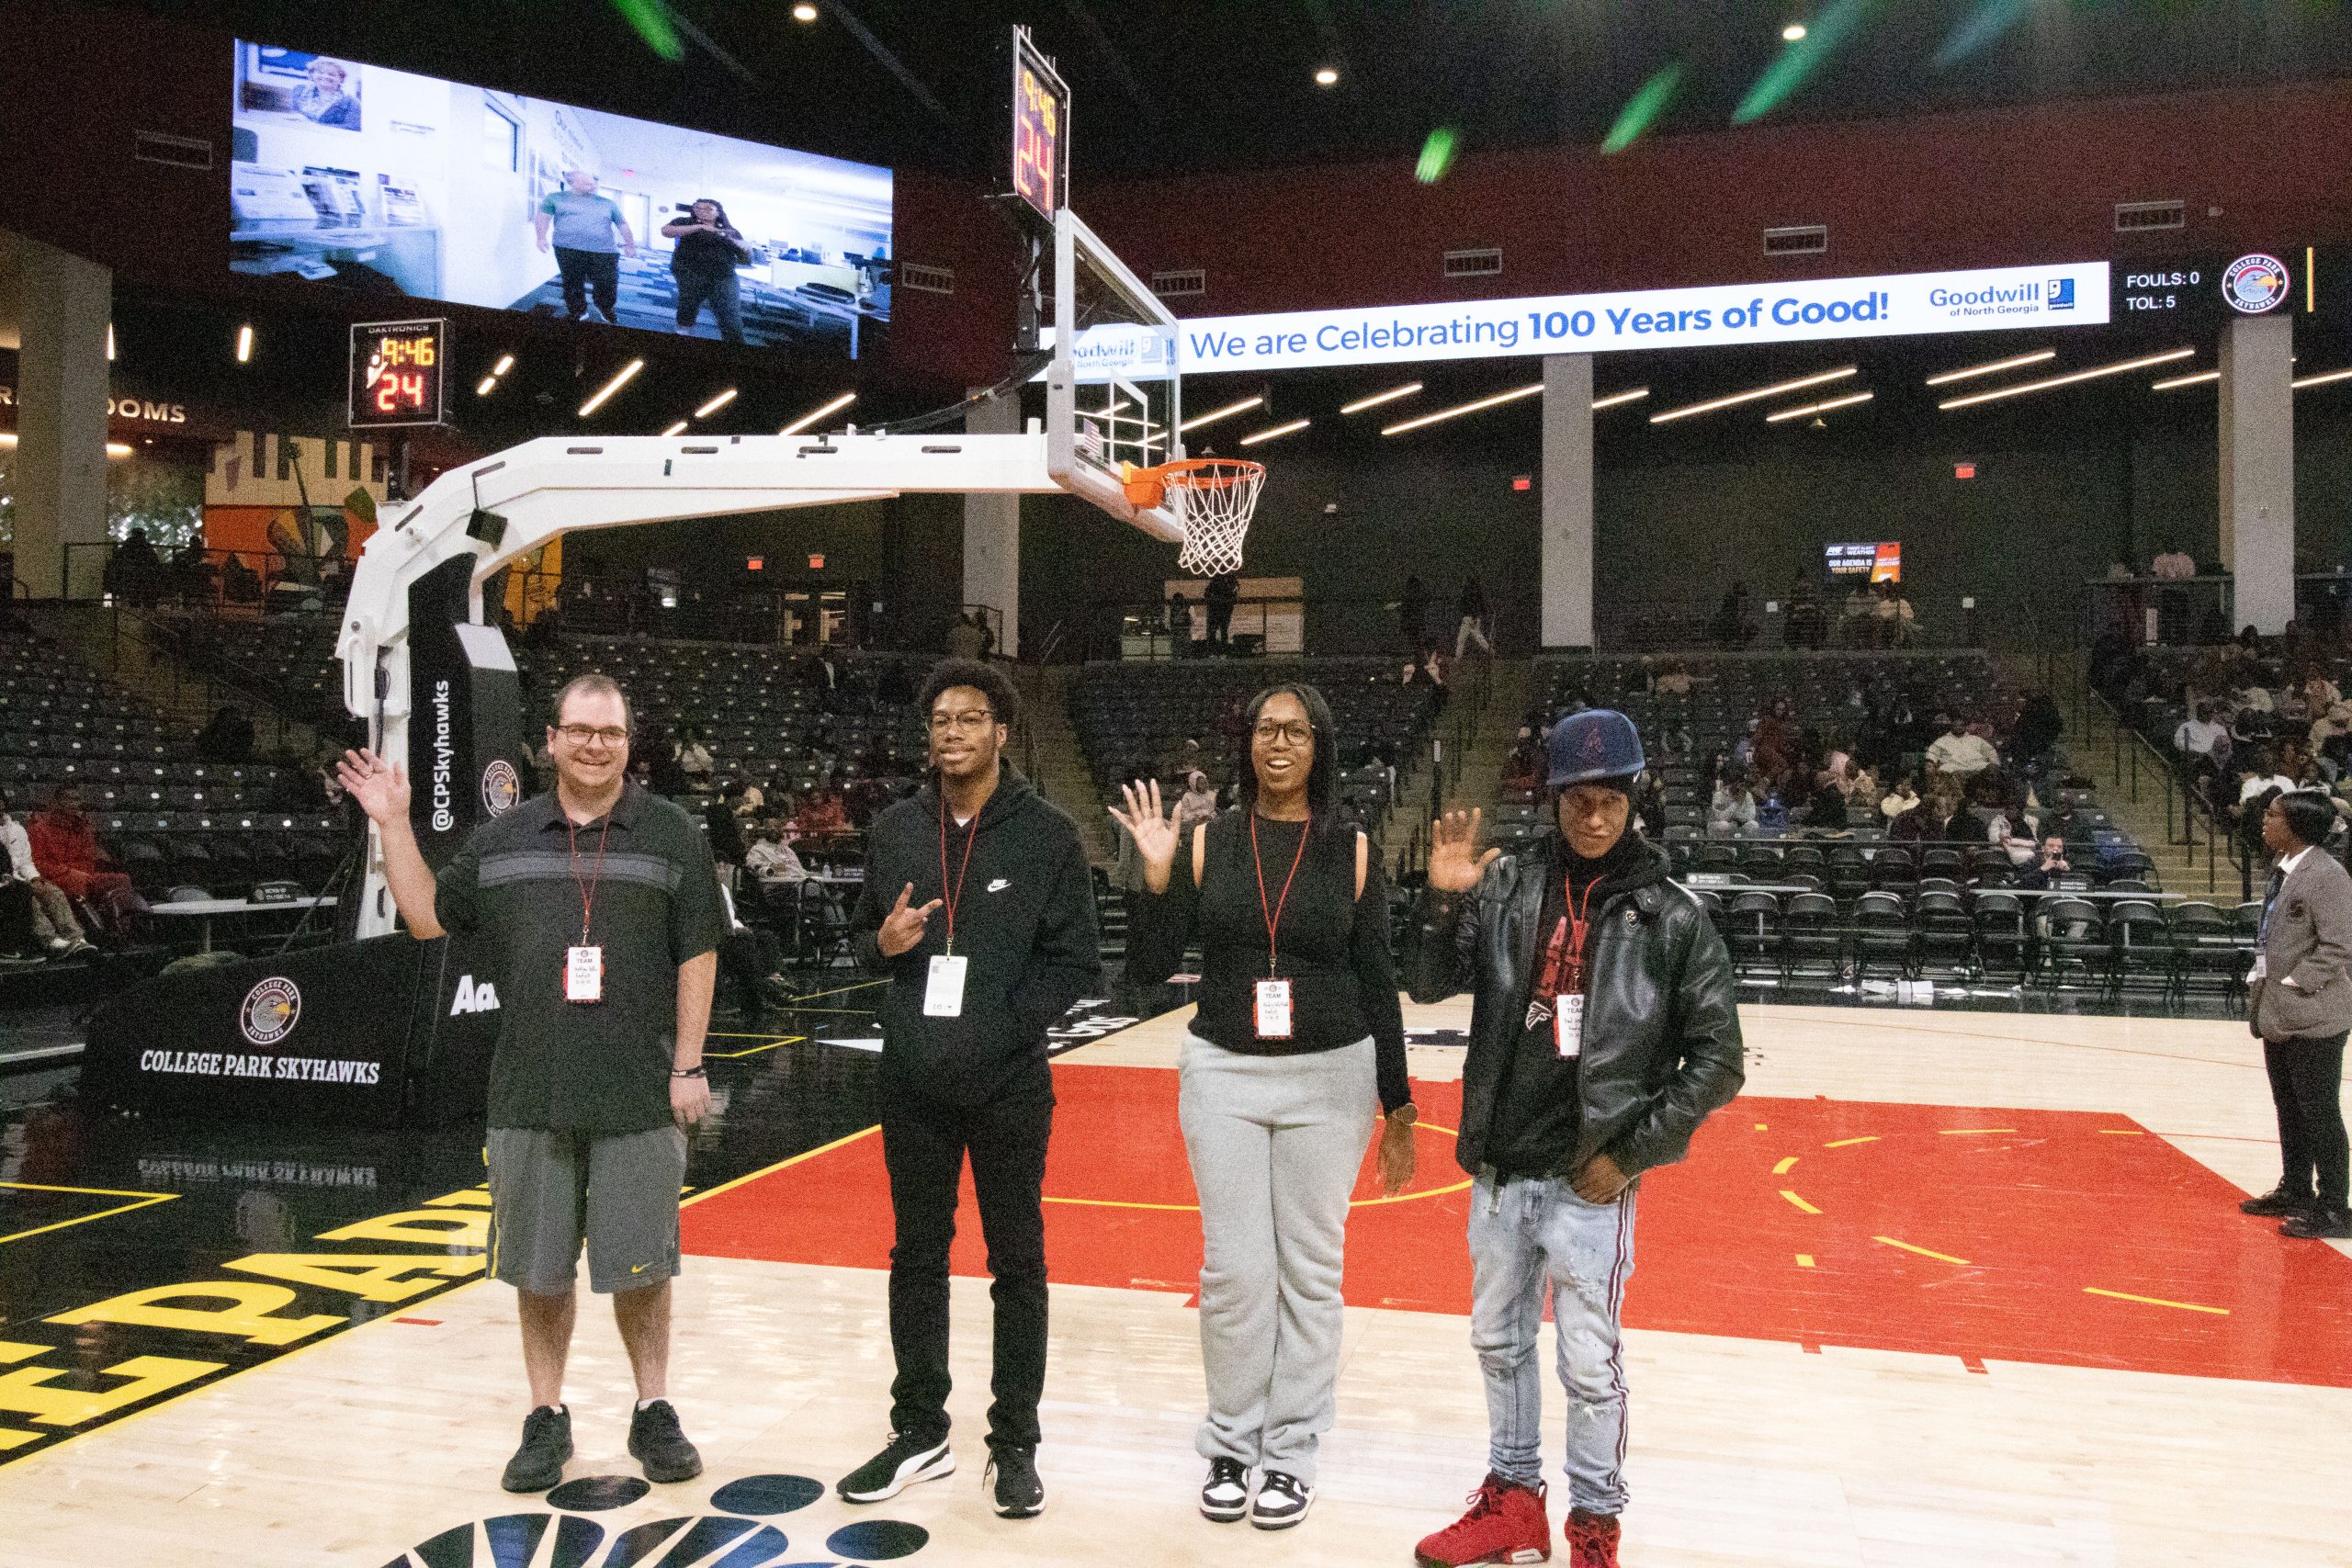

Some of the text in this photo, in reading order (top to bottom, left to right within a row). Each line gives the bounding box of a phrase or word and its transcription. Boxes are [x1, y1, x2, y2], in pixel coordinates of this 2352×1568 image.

[1017, 115, 1051, 210] 24
[1929, 283, 2040, 307] Goodwill
[2126, 271, 2199, 288] FOULS: 0
[1950, 304, 2040, 317] of North Georgia
[2126, 295, 2176, 310] TOL: 5
[368, 324, 430, 333] DAKTRONICS
[1191, 332, 1245, 359] We
[1254, 333, 1307, 355] are
[1317, 315, 1520, 352] Celebrating
[1528, 310, 1596, 340] 100
[1606, 307, 1713, 335] Years
[1722, 298, 1764, 329] of
[1771, 291, 1890, 326] Good!
[382, 336, 435, 367] 9:46
[378, 373, 423, 411] 24
[432, 680, 454, 831] @CPSkyhawks
[251, 981, 282, 999] COLLEGE
[449, 975, 501, 1016] Aa
[141, 1050, 380, 1085] COLLEGE PARK SKYHAWKS
